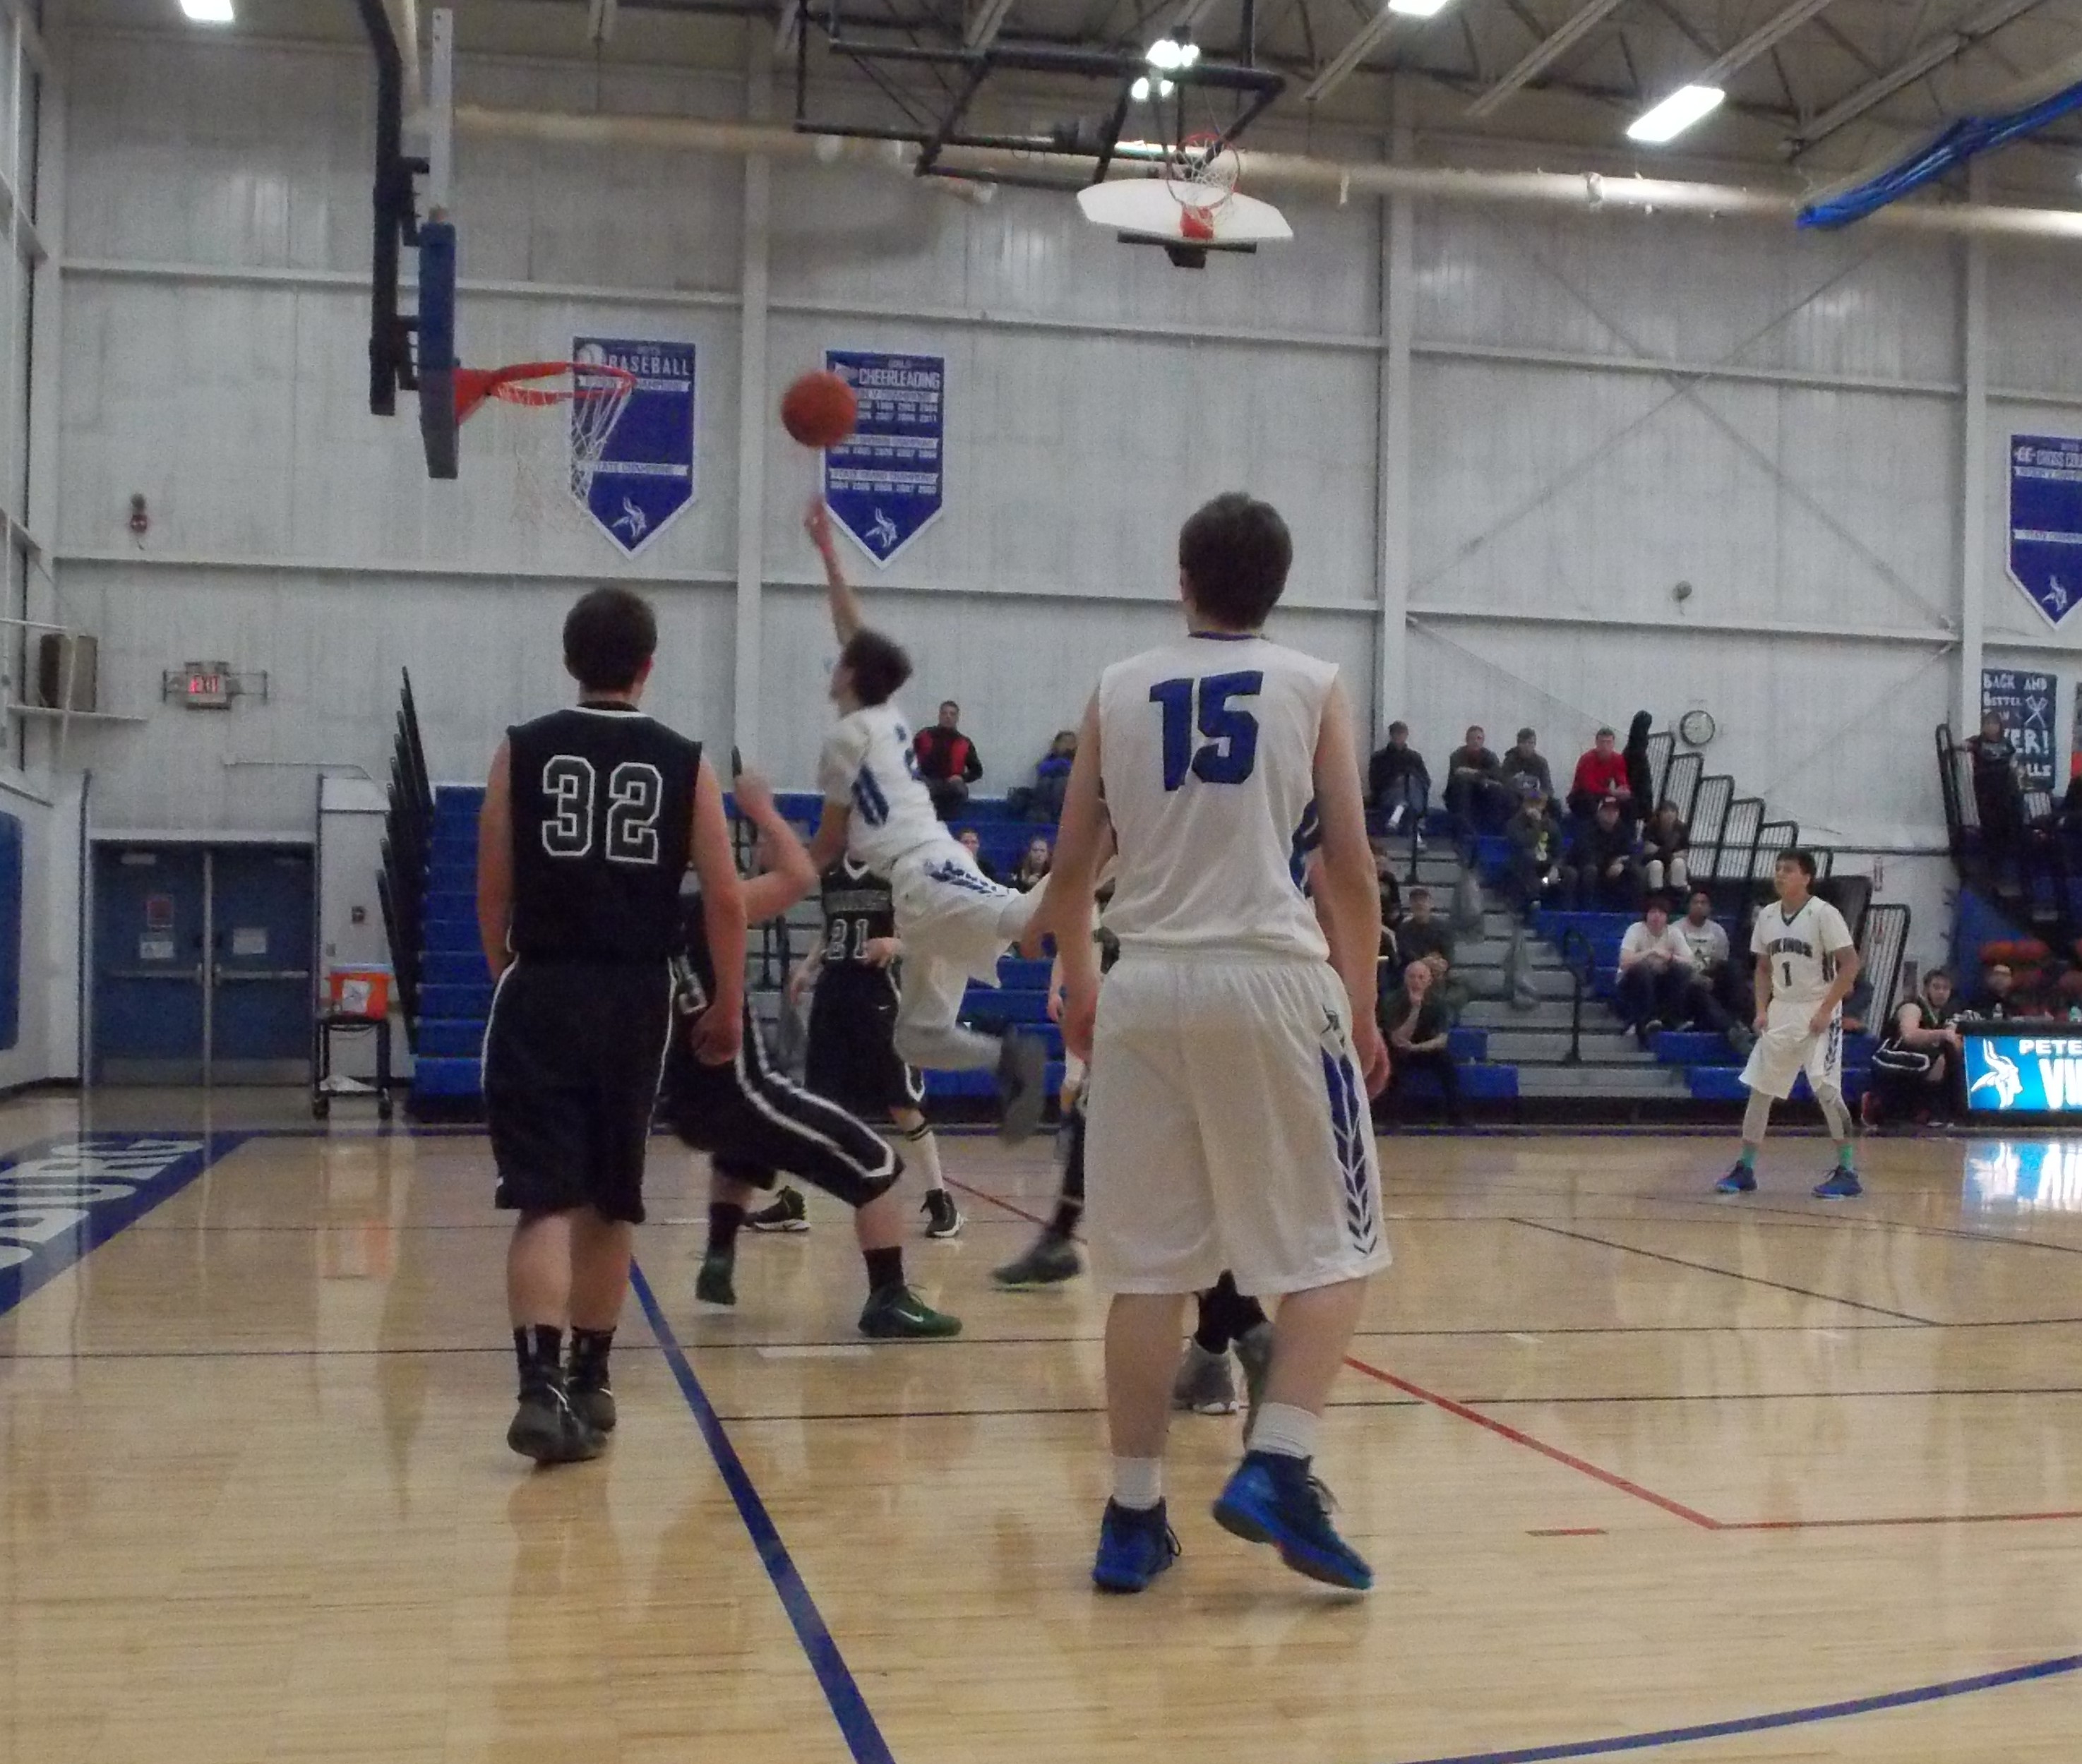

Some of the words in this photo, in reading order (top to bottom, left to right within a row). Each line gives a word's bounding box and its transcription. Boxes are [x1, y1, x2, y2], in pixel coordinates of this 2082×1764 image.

[608, 355, 690, 376] BASEBALL
[859, 368, 940, 389] CHEERLEADING
[191, 675, 218, 694] EXIT
[2023, 677, 2047, 691] AND
[1149, 670, 1264, 791] 15
[542, 755, 663, 865] 32
[827, 918, 869, 959] 21
[1781, 961, 1792, 986] 1
[2019, 1039, 2082, 1055] PETE
